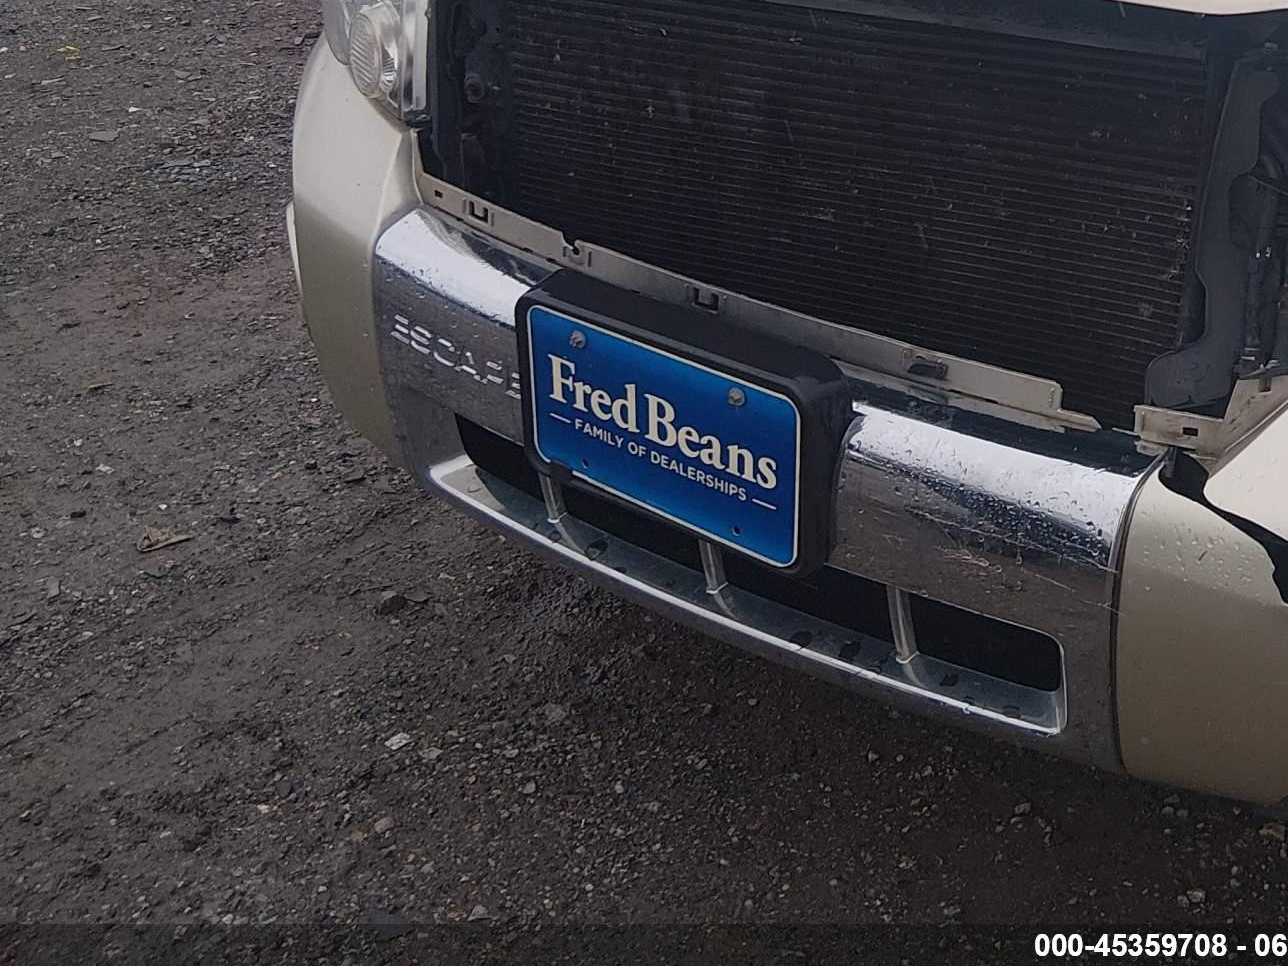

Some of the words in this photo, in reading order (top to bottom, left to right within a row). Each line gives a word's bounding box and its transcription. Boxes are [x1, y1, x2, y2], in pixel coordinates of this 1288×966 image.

[547, 353, 640, 433] Fred
[644, 393, 777, 490] Beans
[575, 418, 624, 449] FAMILY
[627, 441, 647, 457] OF
[650, 450, 748, 501] DEALERSHIPS
